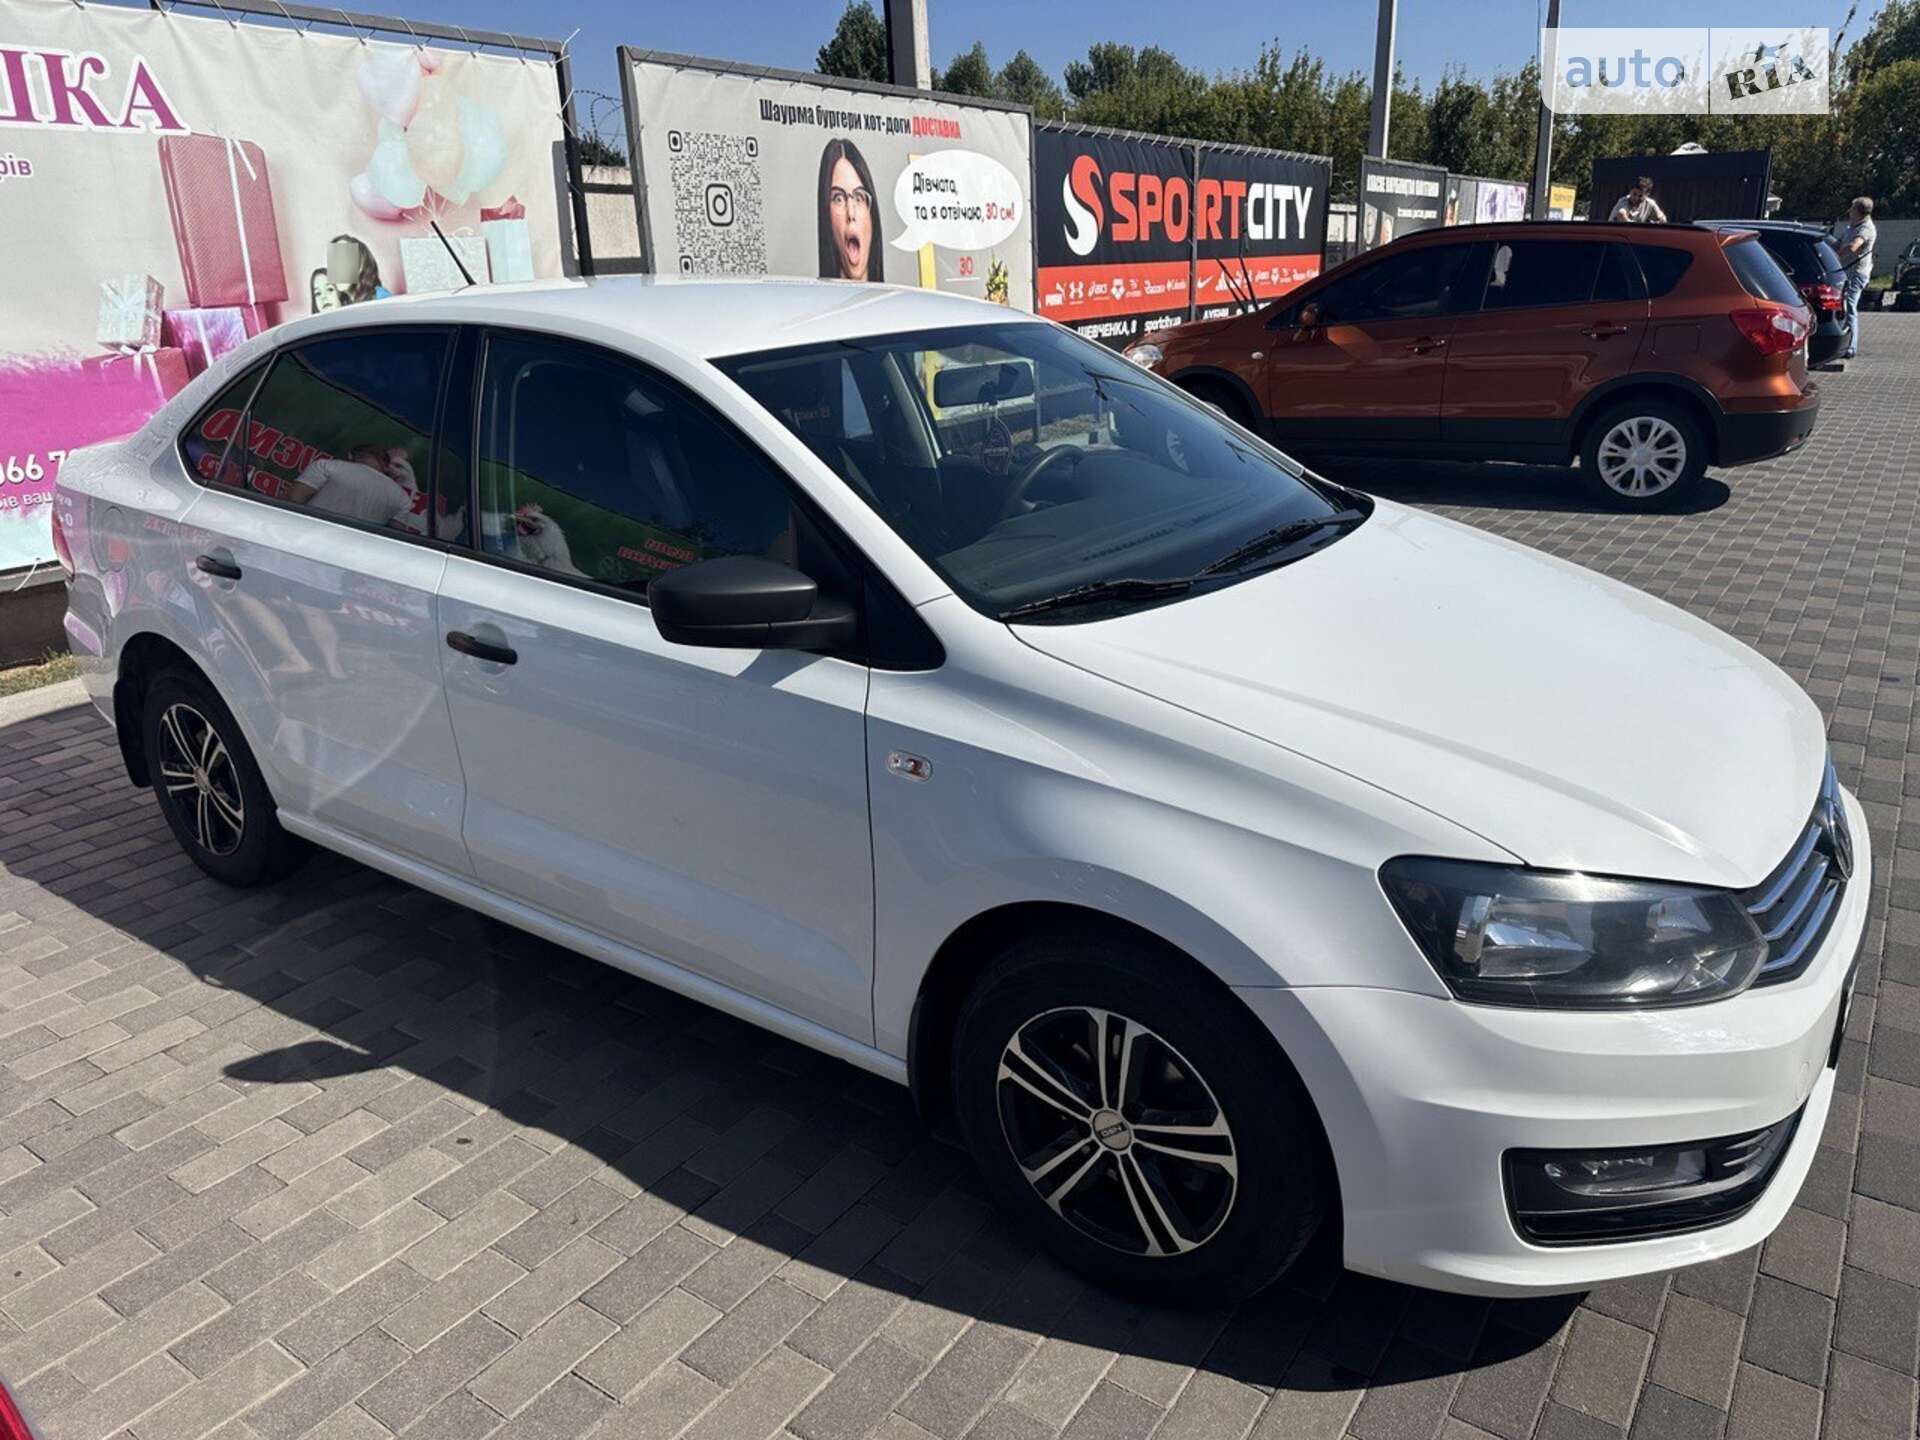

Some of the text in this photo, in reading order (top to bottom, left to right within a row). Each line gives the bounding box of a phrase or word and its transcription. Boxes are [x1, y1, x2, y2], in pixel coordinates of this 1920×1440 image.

[760, 99, 961, 138] Шаурма бургери хот-доги ДОСТАВКА
[913, 172, 958, 196] Дівчата,
[914, 201, 1015, 223] та я отвічаю, 30 см!
